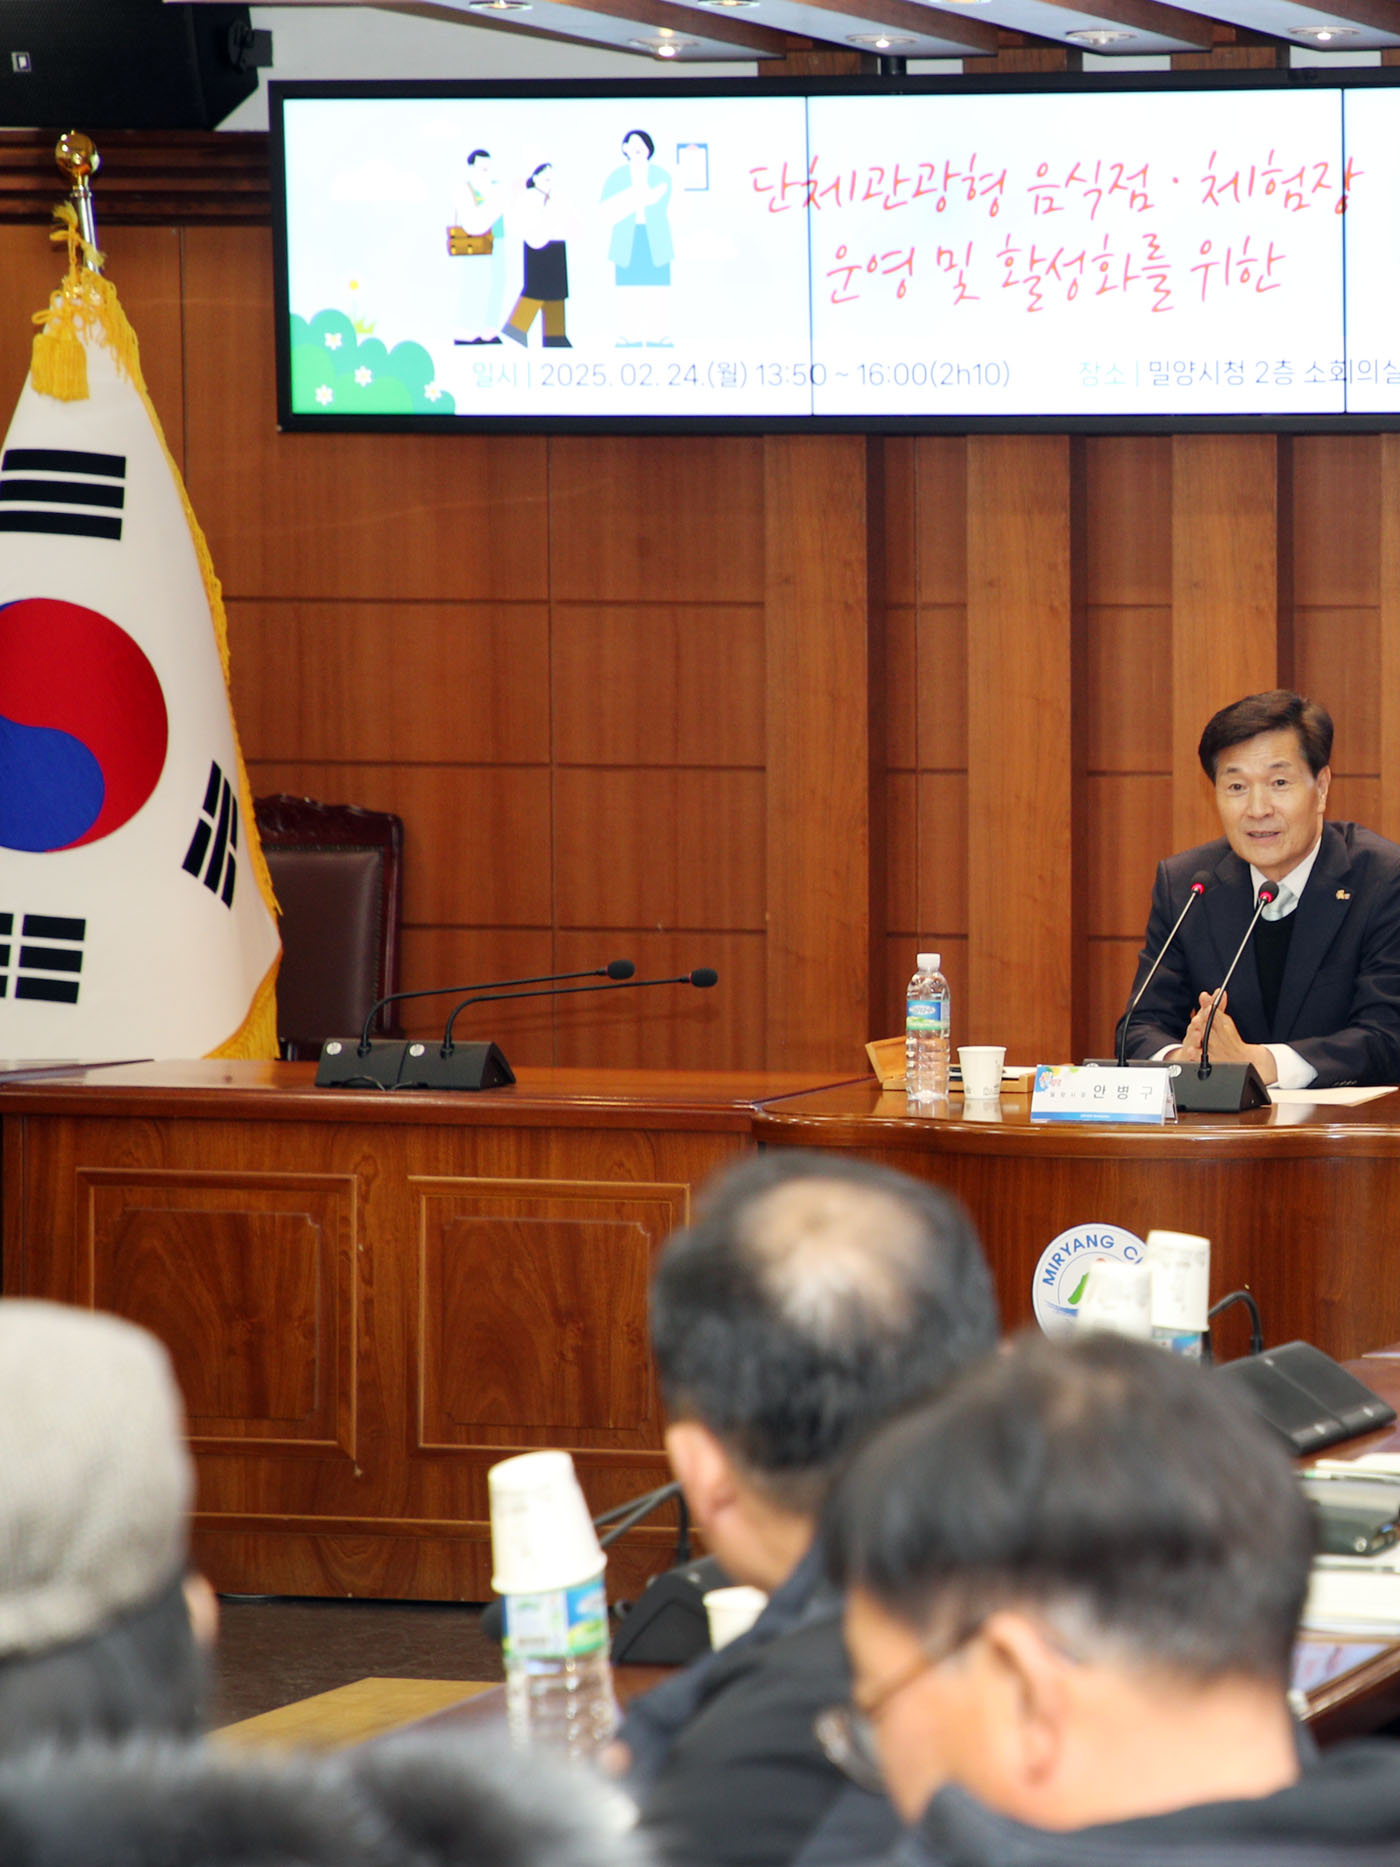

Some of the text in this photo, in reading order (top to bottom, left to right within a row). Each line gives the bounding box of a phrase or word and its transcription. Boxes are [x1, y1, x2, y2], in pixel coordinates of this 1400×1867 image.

[749, 153, 1007, 218] 단체관광형
[1027, 160, 1150, 220] 음식점
[1200, 149, 1364, 215] 체험장
[826, 233, 1287, 313] 운영 및 활성화를 위한
[472, 361, 518, 389] 일시
[540, 362, 607, 388] 2025.
[621, 362, 659, 388] 02.
[756, 361, 827, 387] 13:50
[857, 360, 1011, 389] 16:00(2h10)
[1080, 361, 1126, 387] 장소
[1149, 359, 1245, 387] 밀양시청
[1255, 360, 1295, 386] 2층
[1042, 1234, 1115, 1286] MIRYANG
[1123, 1246, 1144, 1265] CI
